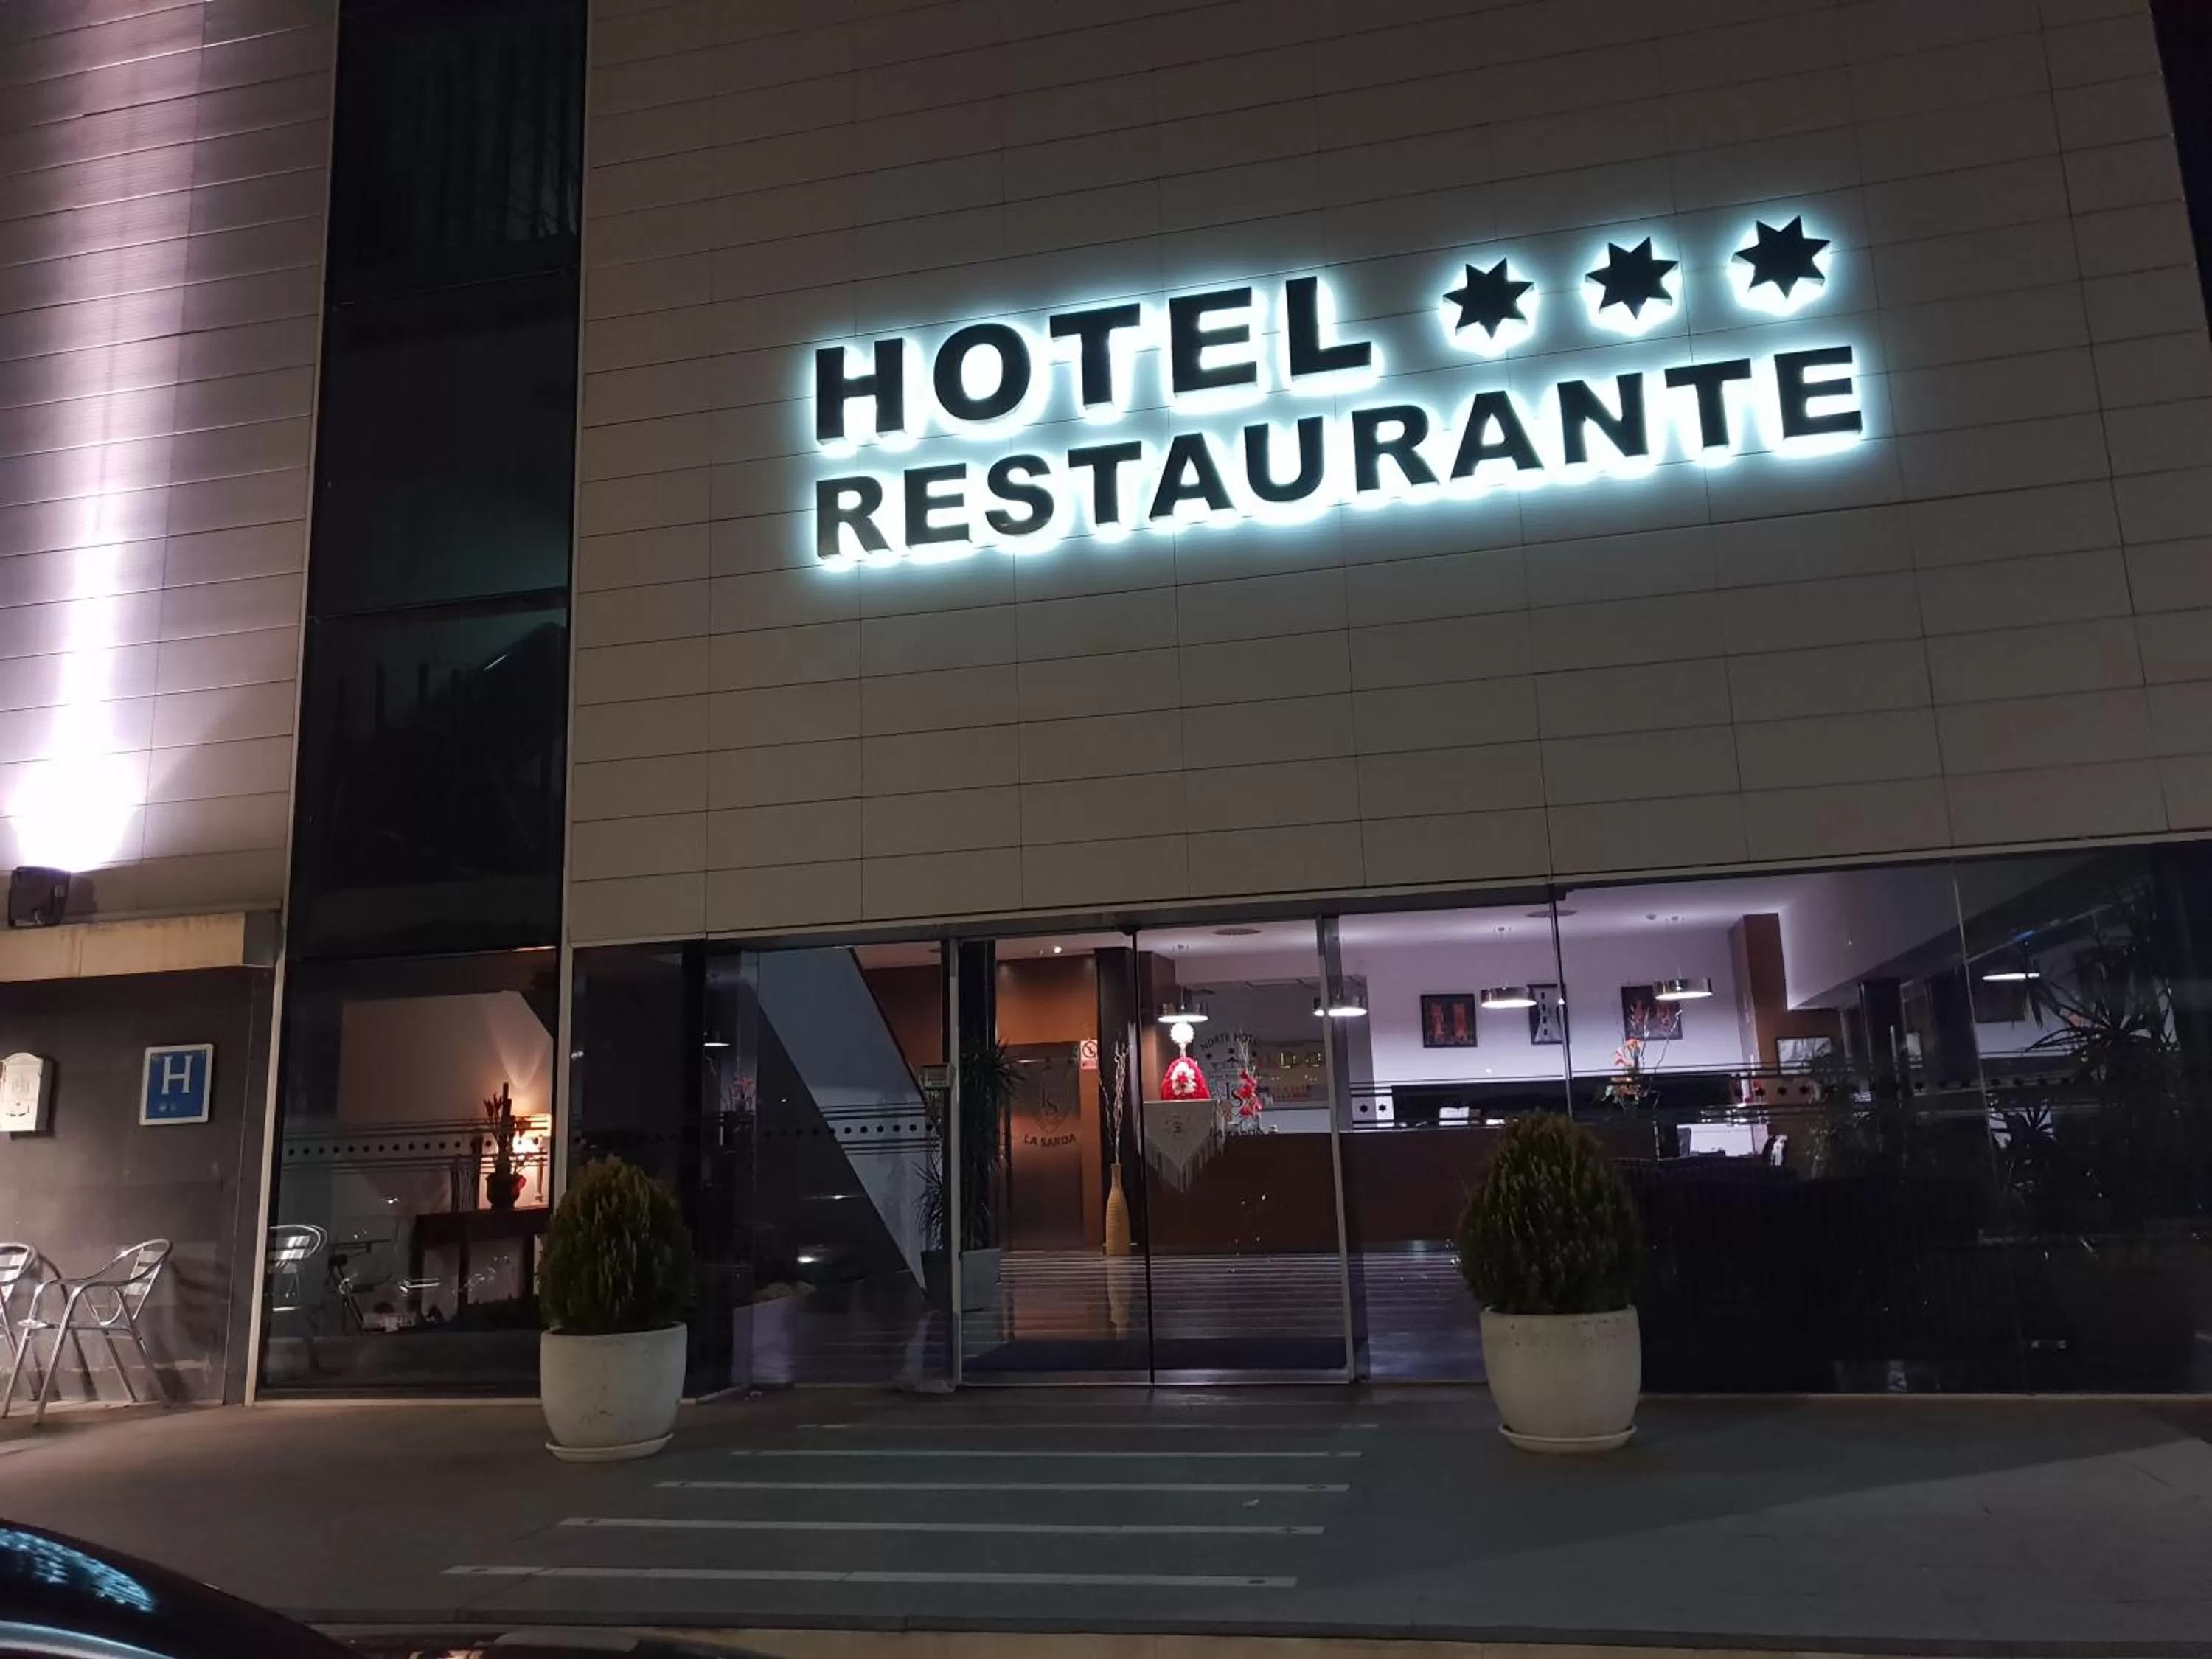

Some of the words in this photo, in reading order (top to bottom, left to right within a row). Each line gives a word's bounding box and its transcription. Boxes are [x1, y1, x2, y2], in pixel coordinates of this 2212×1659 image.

[815, 276, 1372, 446] HOTEL
[816, 345, 1863, 560] RESTAURANTE
[161, 1054, 193, 1095] H
[1024, 1133, 1037, 1146] LA
